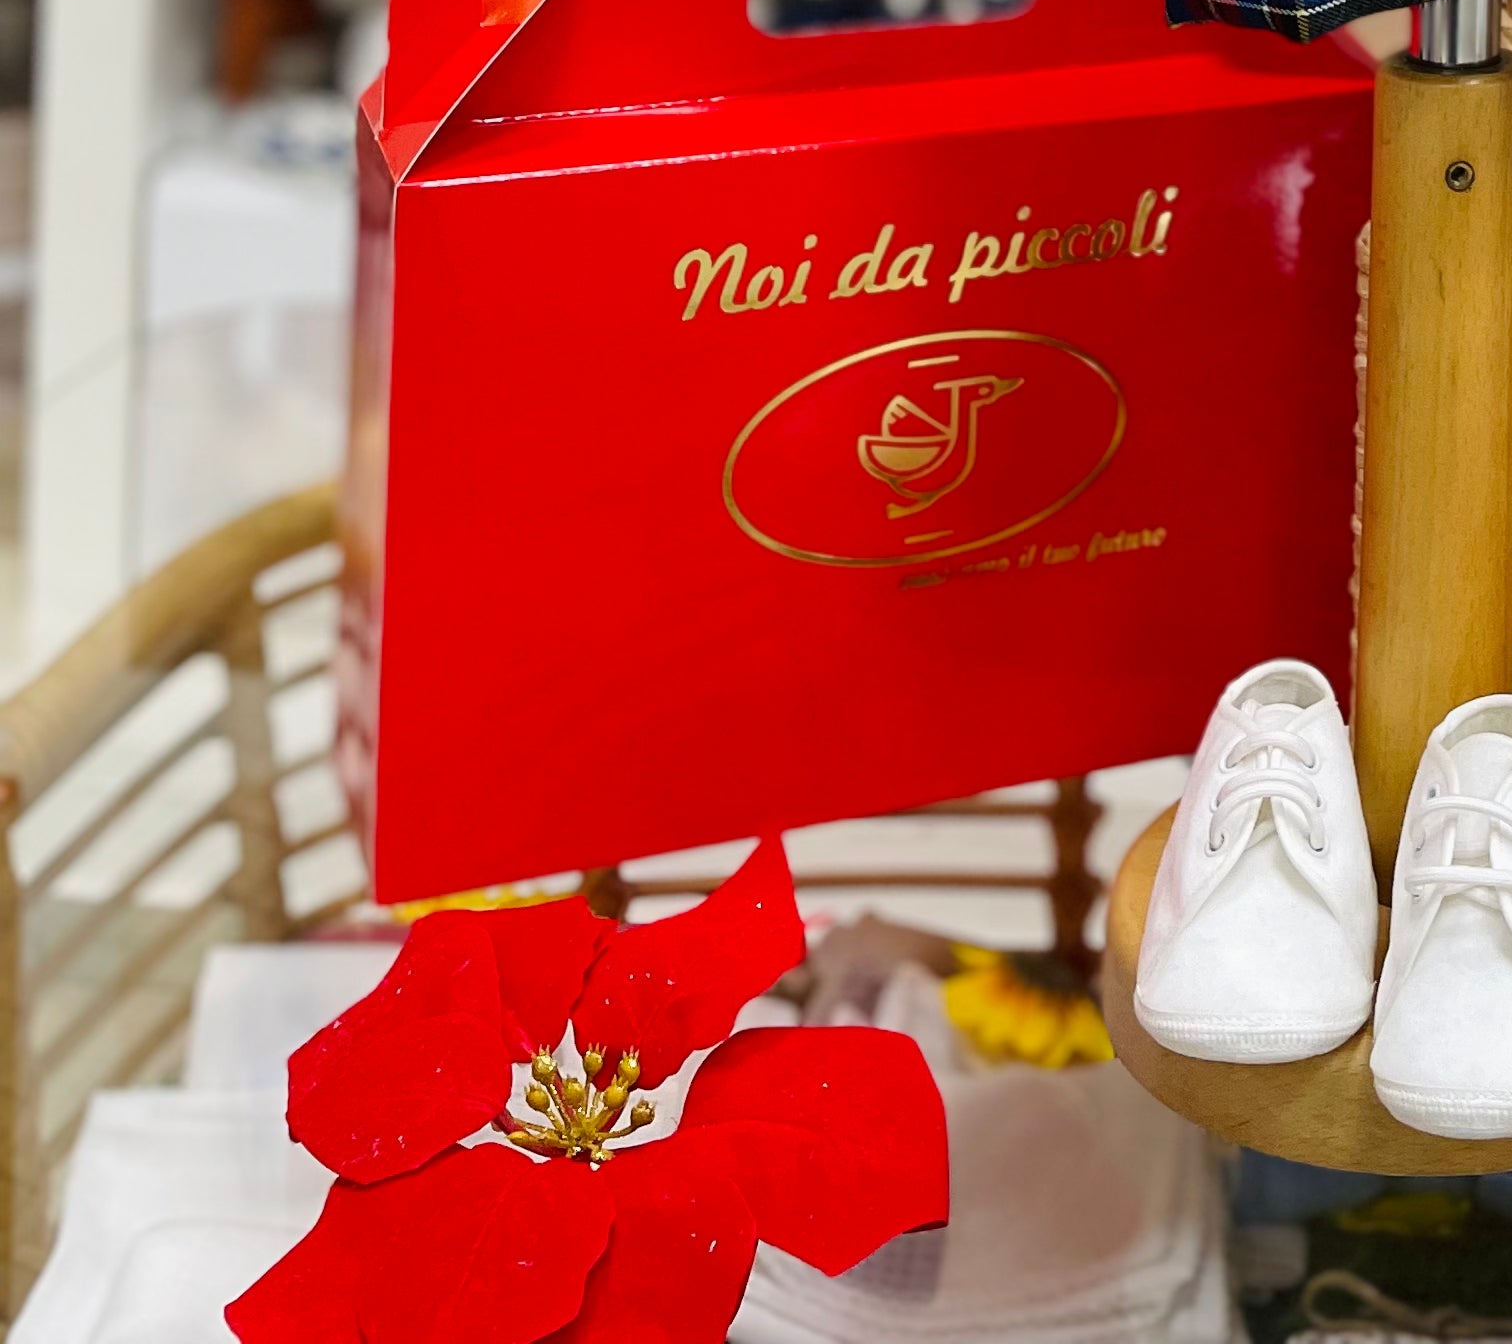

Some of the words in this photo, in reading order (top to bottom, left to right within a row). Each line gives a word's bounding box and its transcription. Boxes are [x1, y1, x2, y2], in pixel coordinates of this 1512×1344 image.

[673, 233, 819, 322] Noi
[828, 223, 935, 301] da
[947, 185, 1180, 305] piccoli
[1085, 526, 1168, 562] futuro
